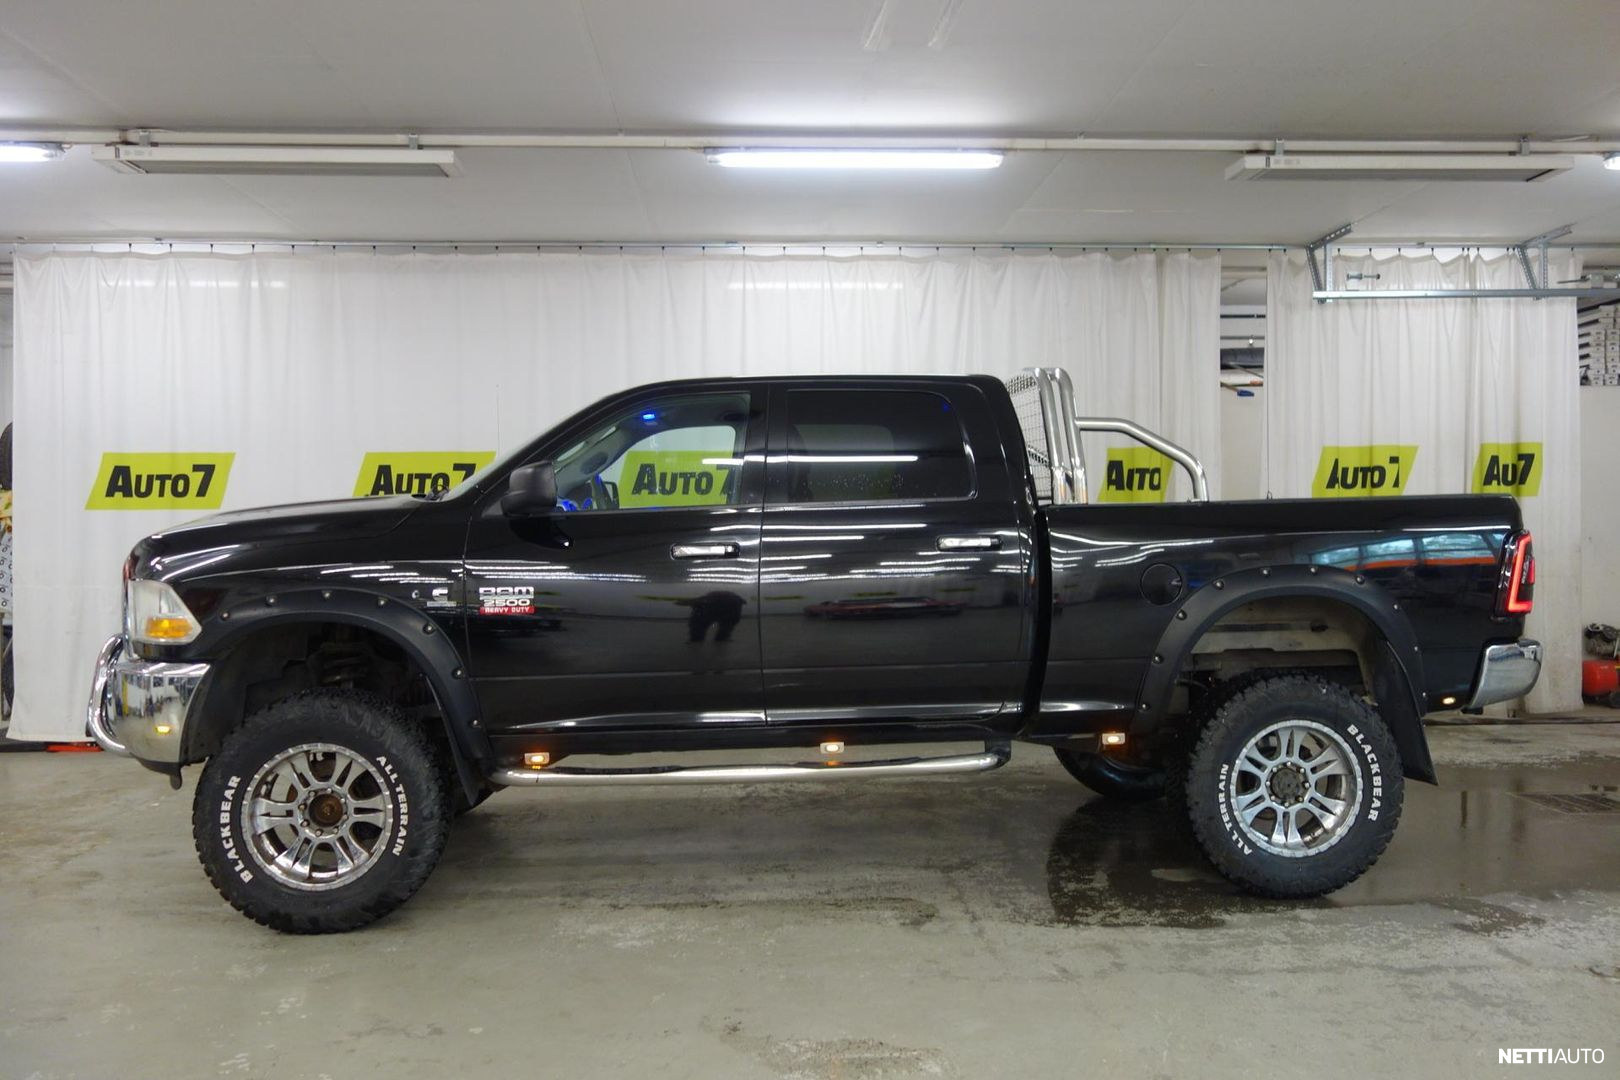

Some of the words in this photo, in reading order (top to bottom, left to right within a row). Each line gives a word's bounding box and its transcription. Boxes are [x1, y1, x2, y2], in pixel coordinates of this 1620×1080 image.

[479, 586, 534, 600] RAM
[483, 599, 531, 607] 2500
[376, 756, 398, 783] ALL
[392, 784, 409, 856] TERRAIN
[1218, 763, 1232, 832] TERRAIN
[1347, 724, 1382, 821] BLACKBEAR
[220, 775, 254, 884] BLACKBEAR
[1232, 830, 1253, 855] ALL
